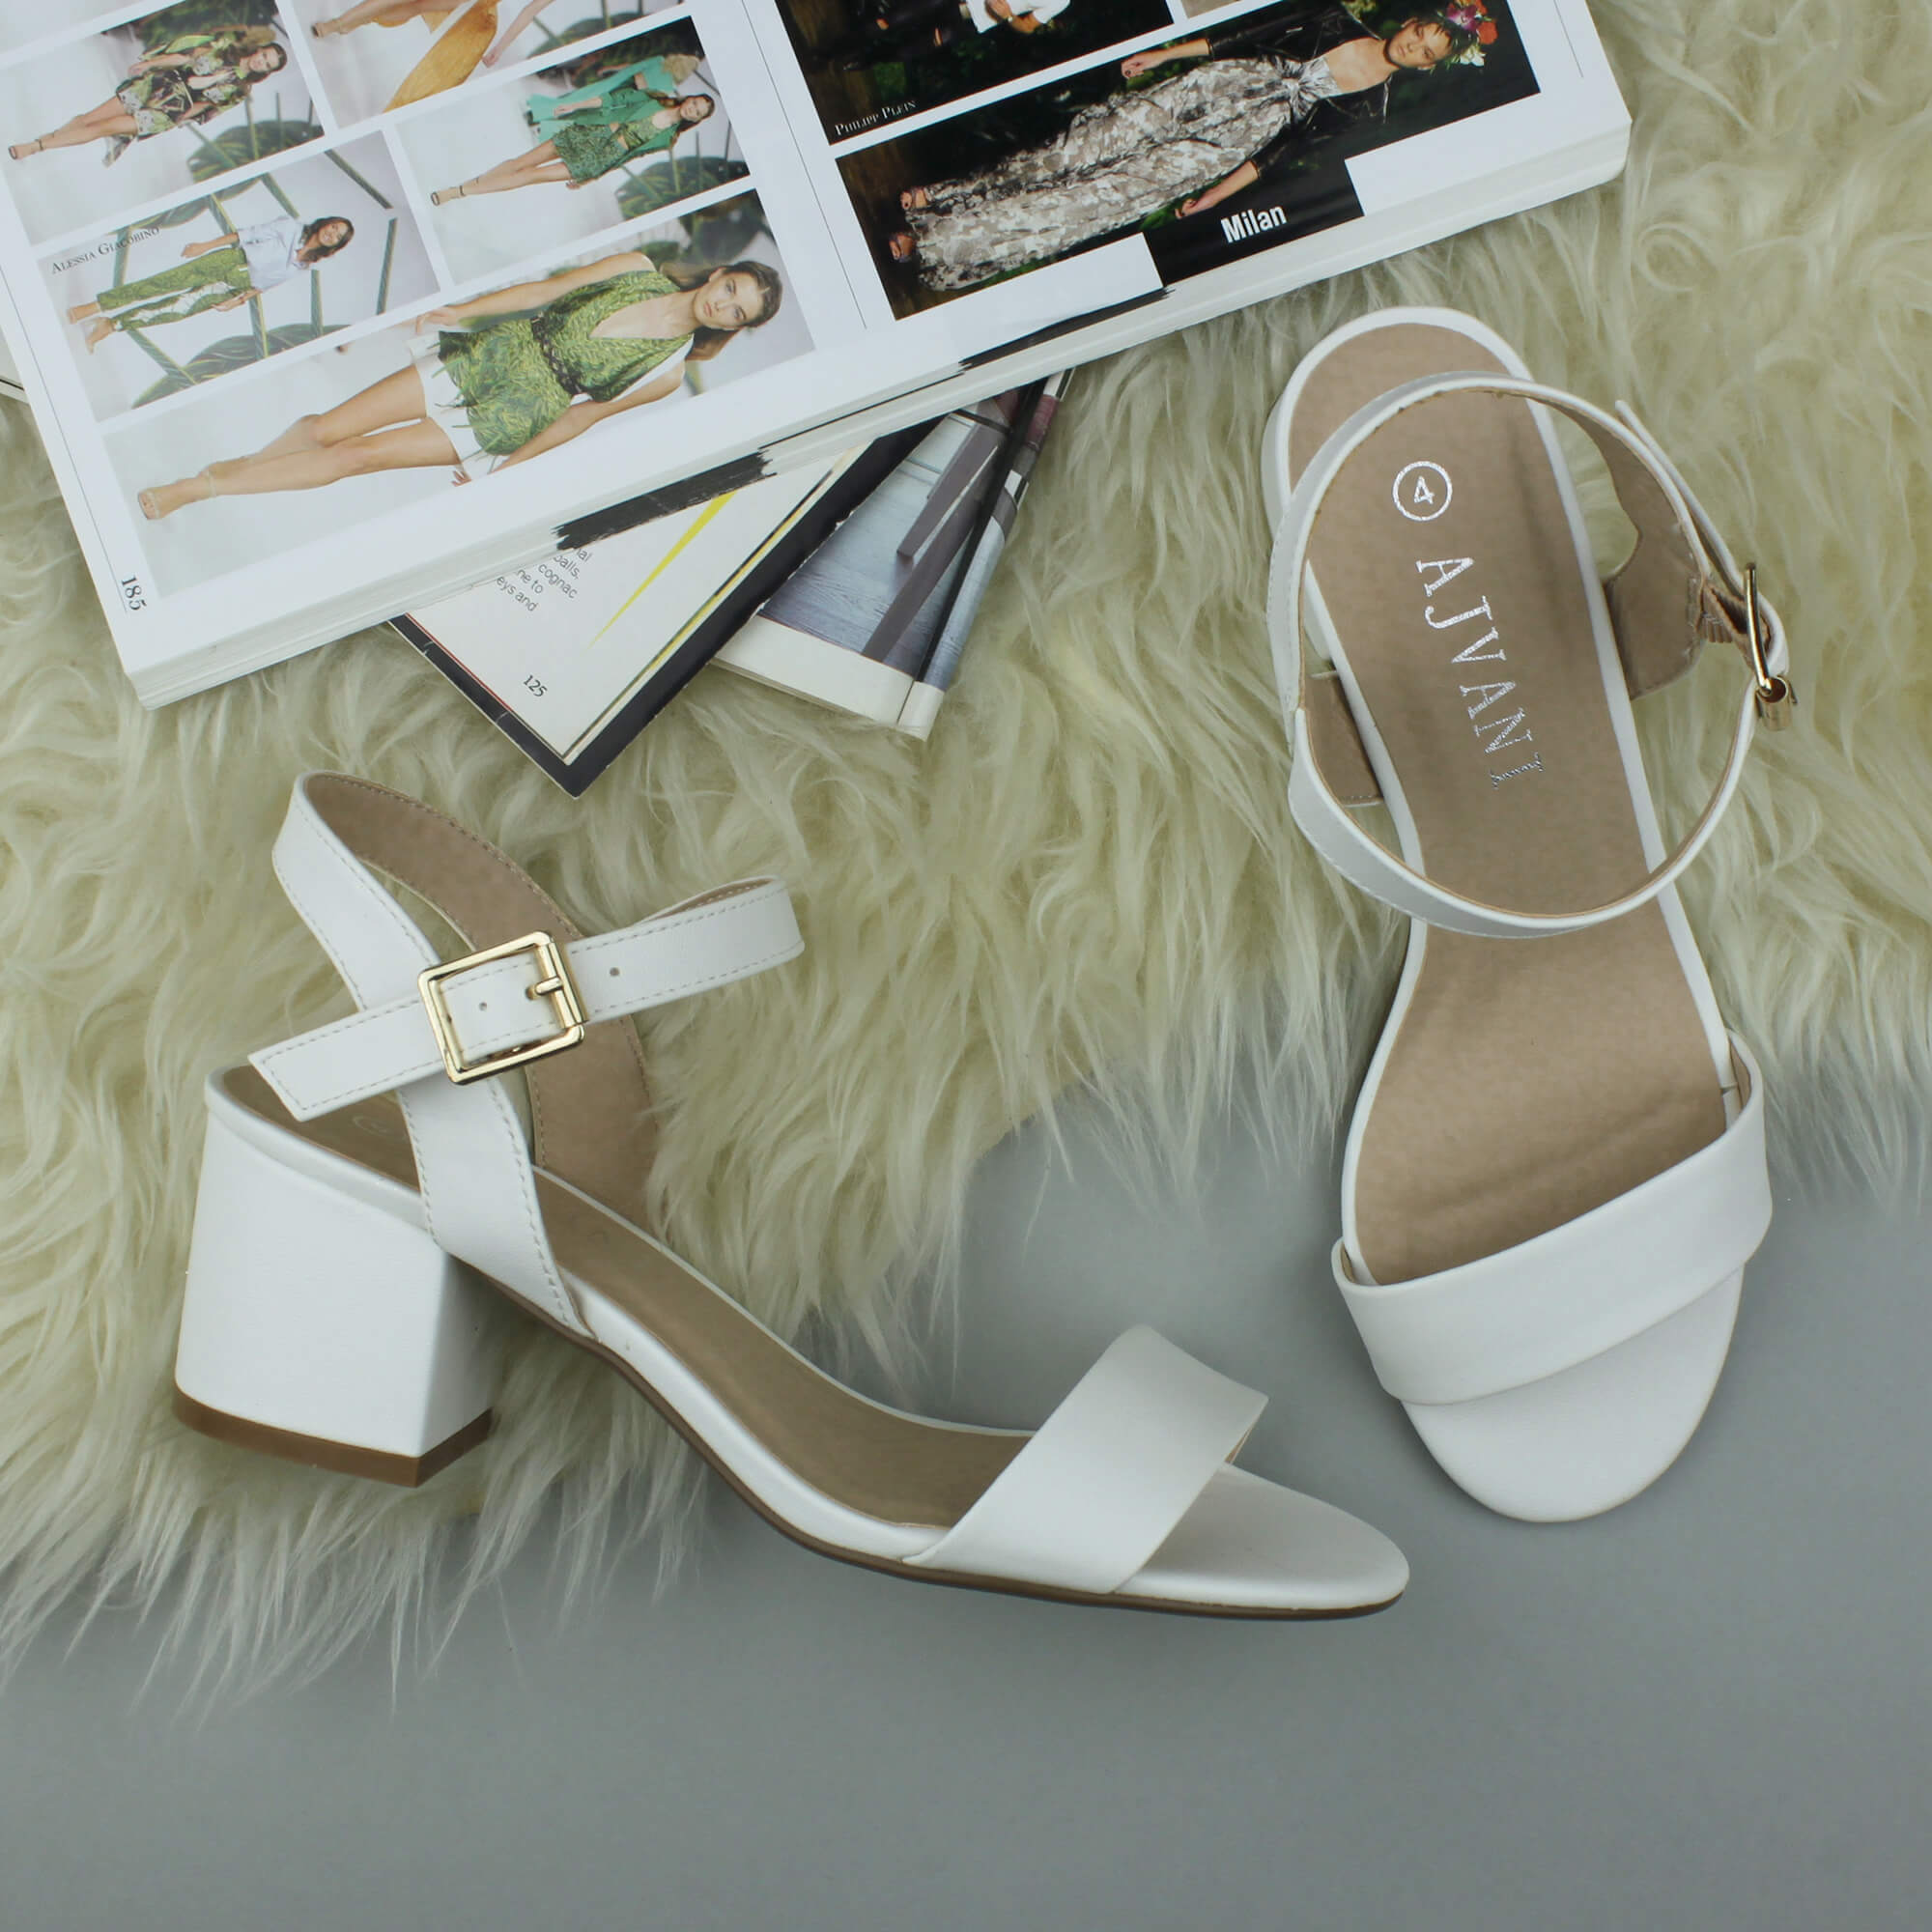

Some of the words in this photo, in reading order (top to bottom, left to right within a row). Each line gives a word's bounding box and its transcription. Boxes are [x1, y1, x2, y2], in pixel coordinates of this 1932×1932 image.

[1220, 206, 1287, 243] Milan
[51, 251, 97, 274] ALESSIA
[1413, 475, 1435, 505] 4
[122, 577, 147, 611] 185
[530, 579, 544, 594] to
[538, 563, 579, 600] cognac
[514, 591, 540, 611] and
[524, 674, 548, 696] 125
[1415, 556, 1545, 789] AJVANI
